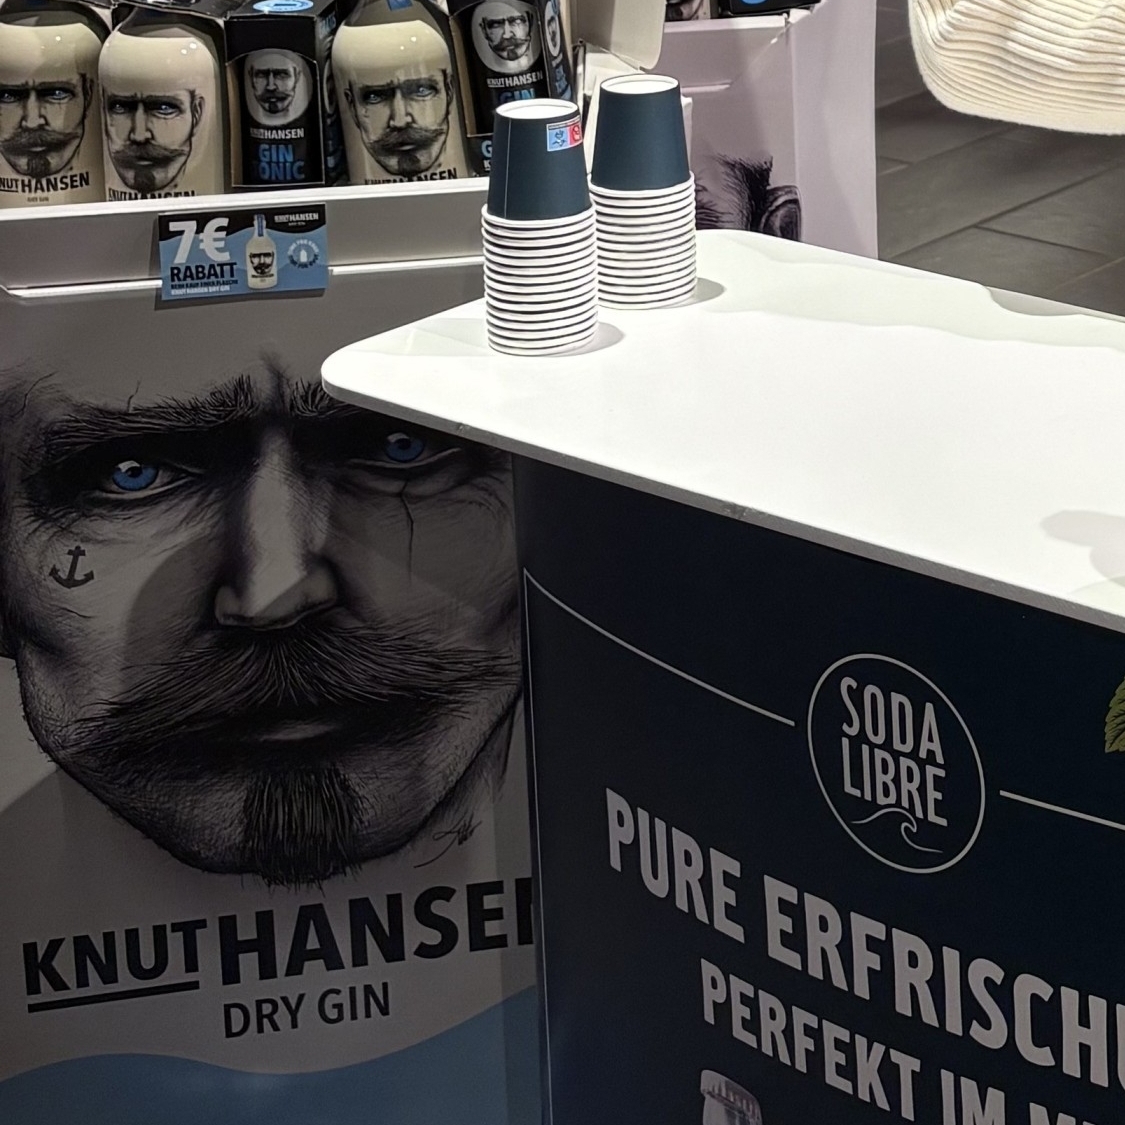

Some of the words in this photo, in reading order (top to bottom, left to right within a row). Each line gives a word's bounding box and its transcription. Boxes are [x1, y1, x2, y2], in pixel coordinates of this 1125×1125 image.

[258, 143, 294, 163] GIN
[258, 161, 306, 181] ONIC
[0, 170, 91, 195] NUTHANSEN
[169, 217, 231, 264] 7€
[170, 261, 238, 283] RABATT
[840, 676, 945, 765] SODA
[841, 736, 949, 827] LIBRE
[605, 786, 746, 944] PURE
[222, 992, 306, 1040] DRY
[316, 981, 391, 1026] GIN
[700, 957, 922, 1123] PERFEKT
[940, 1067, 1006, 1125] IM
